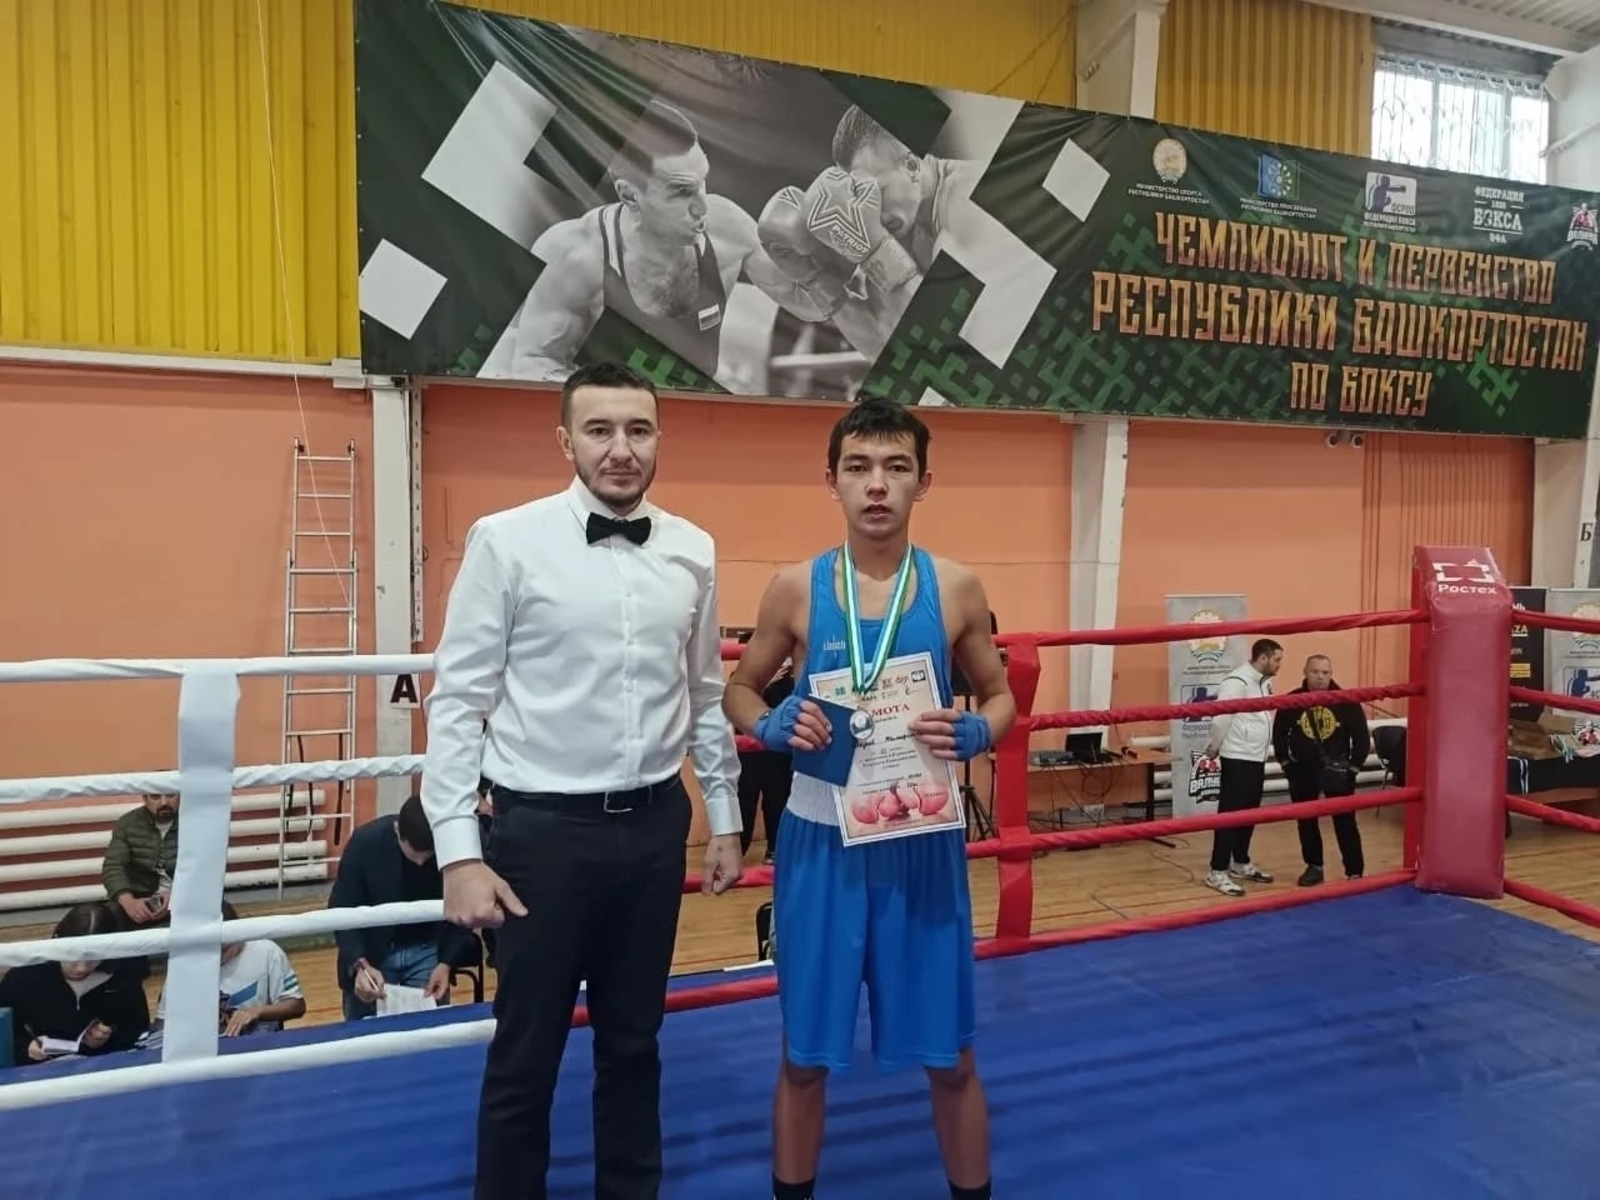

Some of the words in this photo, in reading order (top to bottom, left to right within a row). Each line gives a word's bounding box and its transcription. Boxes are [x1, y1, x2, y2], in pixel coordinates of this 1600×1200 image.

[1474, 186, 1524, 202] ФЕДЕРАЦИЯ
[1473, 207, 1523, 231] БОКСА
[831, 224, 869, 253] PATRIOT
[1155, 211, 1348, 282] ЧЕМПИОНАТ
[1358, 238, 1377, 286] И
[1388, 241, 1556, 305] ПЕРВЕНСТВО
[1092, 270, 1338, 350] РЕСПУБЛИКИ
[1352, 298, 1588, 372] БАШКОРТОСТАН
[1290, 361, 1330, 411] ПО
[1340, 364, 1433, 416] БОКСУ
[1438, 584, 1498, 595] Ростех
